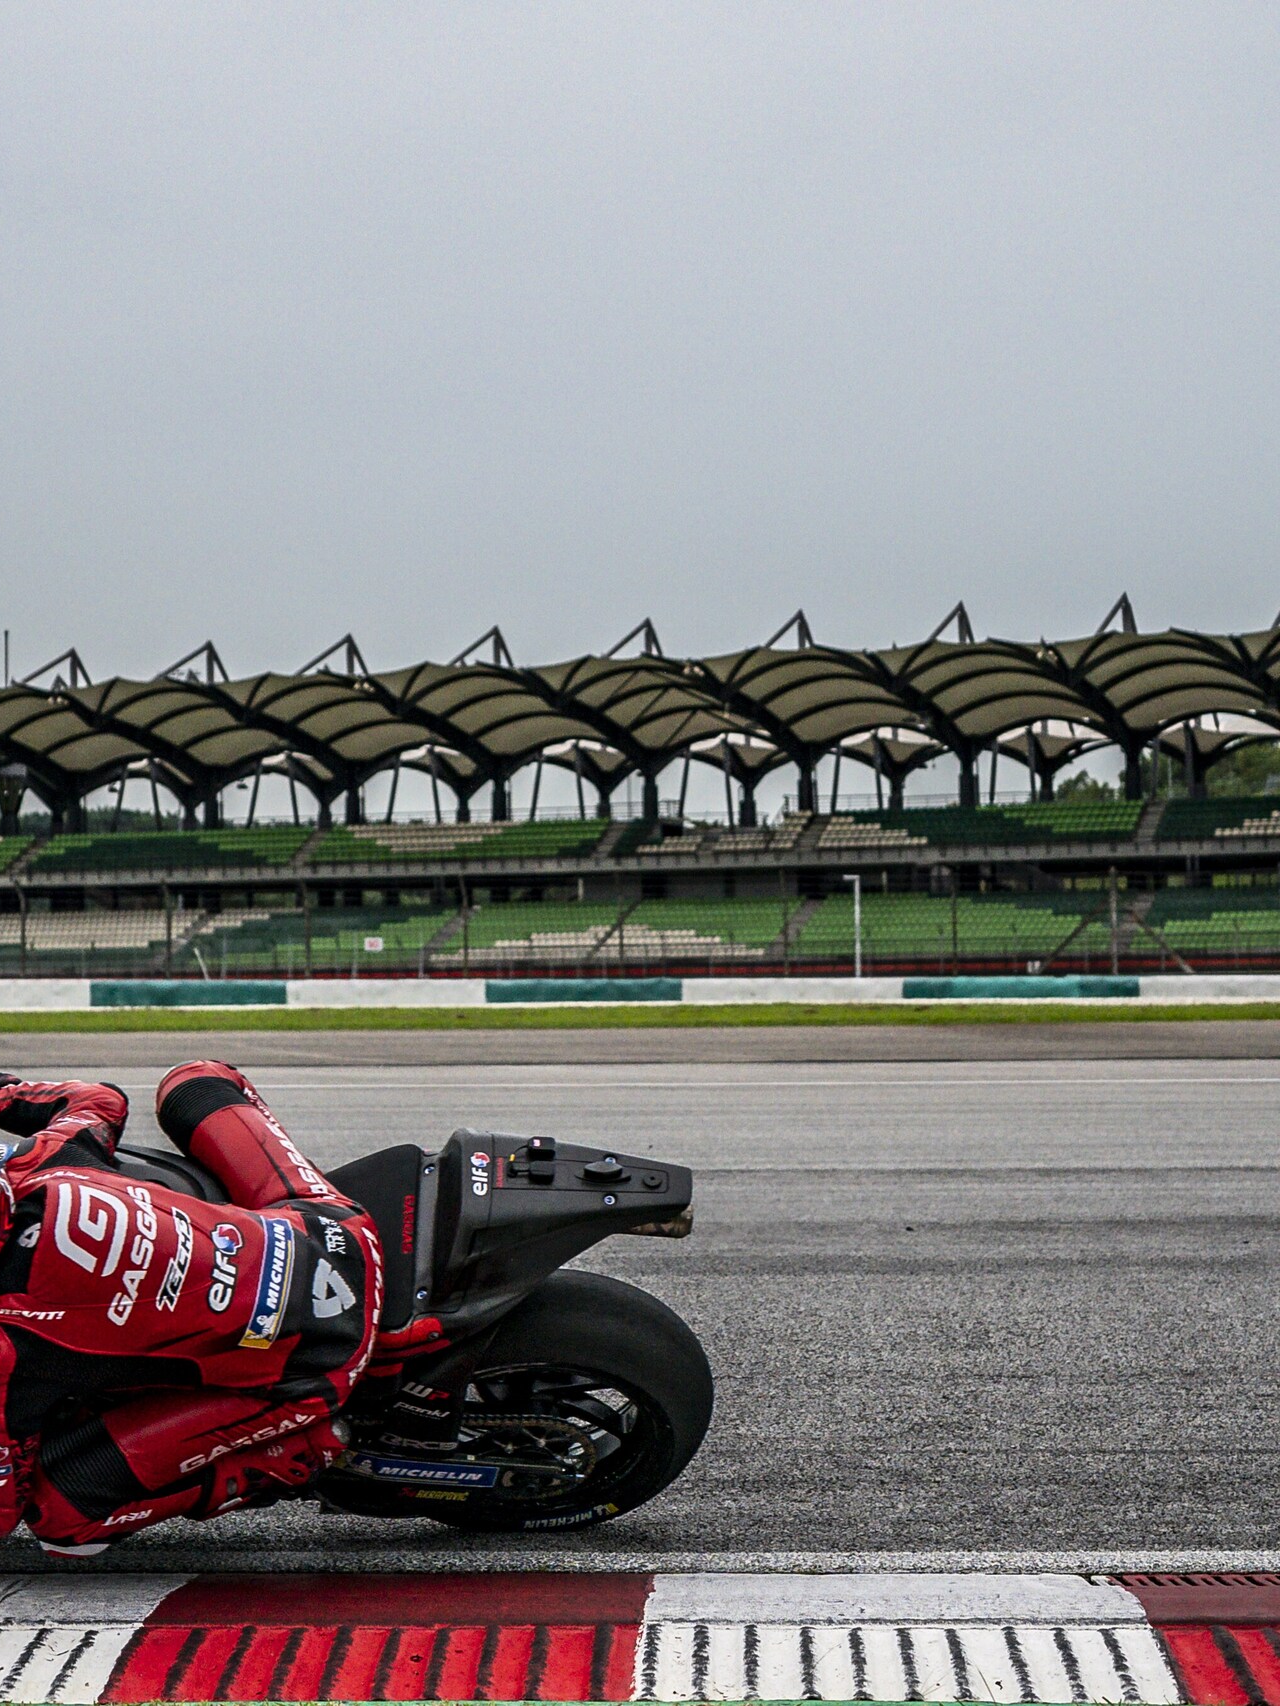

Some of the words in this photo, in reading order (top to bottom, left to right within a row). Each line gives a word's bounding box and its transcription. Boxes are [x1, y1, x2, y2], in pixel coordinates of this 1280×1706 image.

[471, 1166, 489, 1196] elf
[401, 1194, 417, 1255] GASGAS
[107, 1186, 158, 1327] GASGAS
[266, 1222, 287, 1310] MICHELIN
[208, 1250, 237, 1312] elf
[401, 1381, 450, 1400] WP
[393, 1401, 450, 1418] pankl
[378, 1466, 483, 1481] MICHELIN
[523, 1510, 593, 1529] MICHELIN
